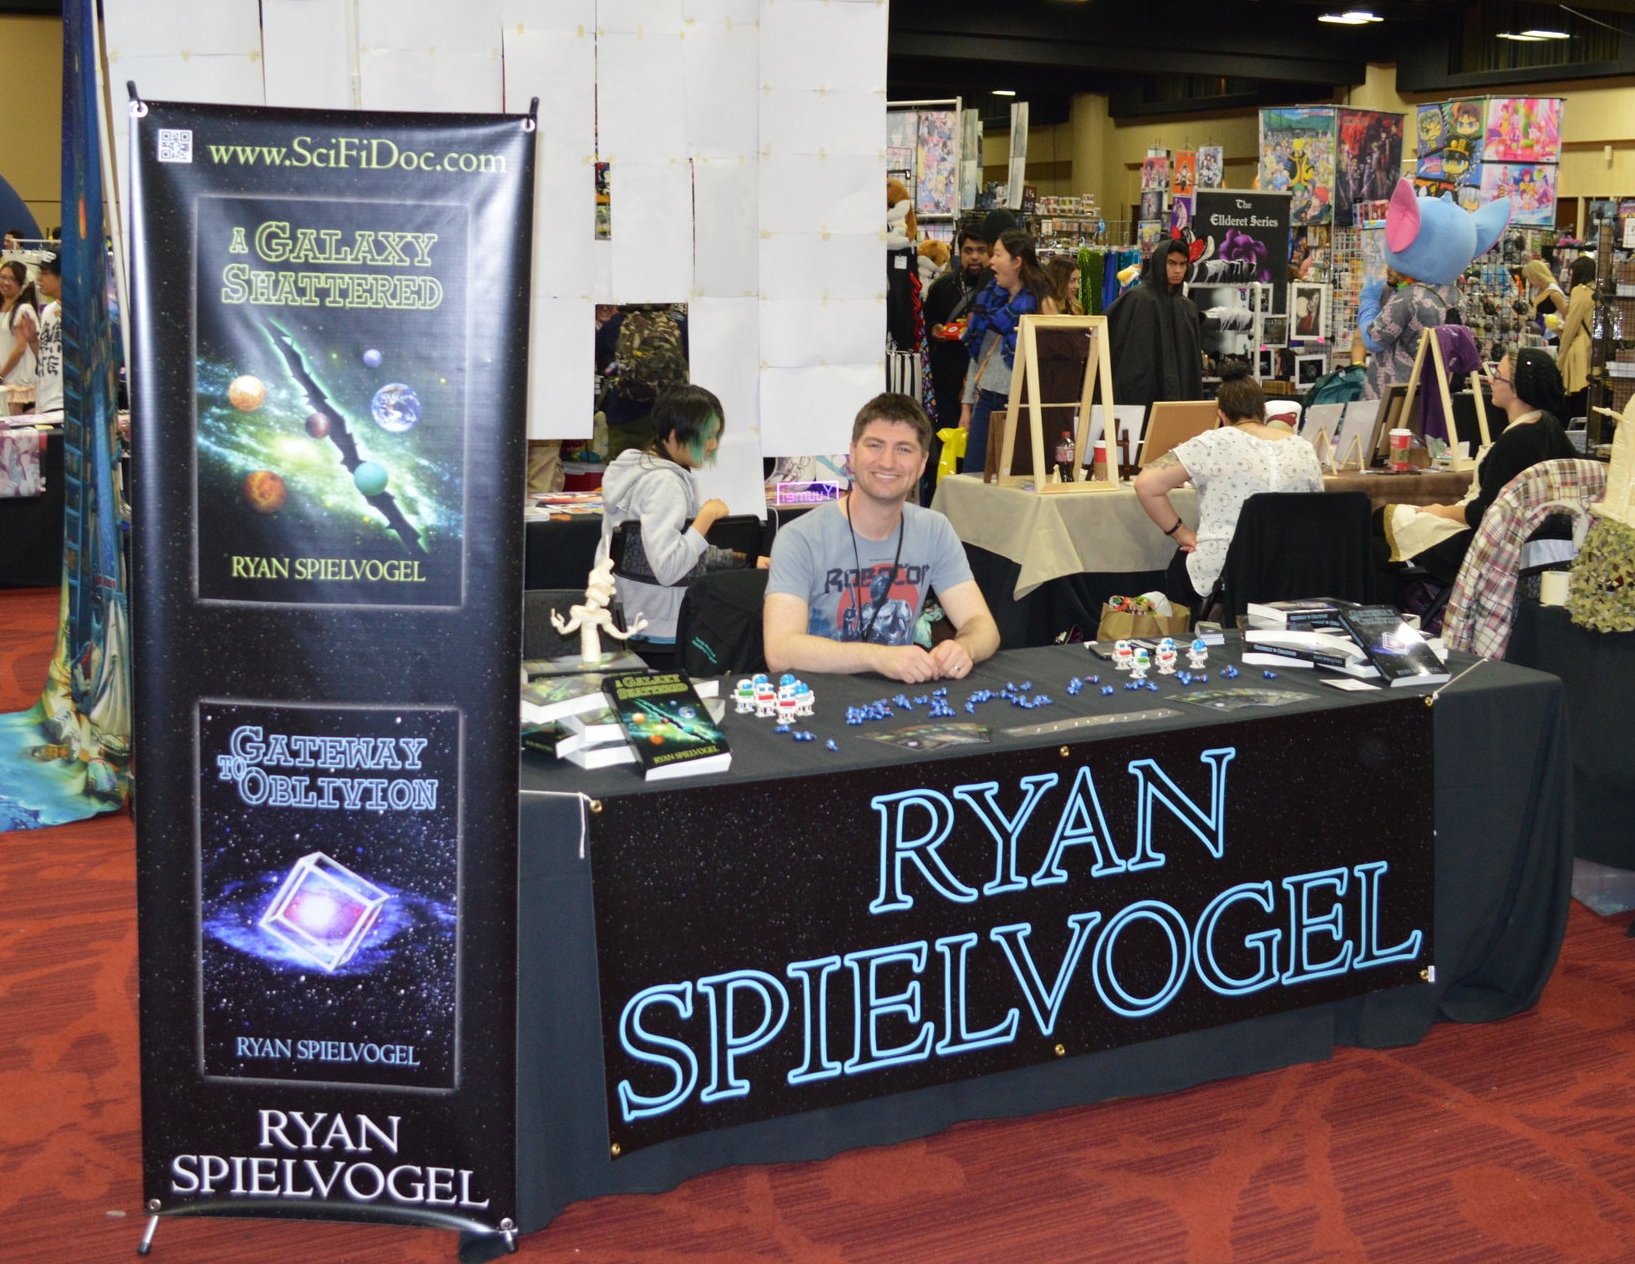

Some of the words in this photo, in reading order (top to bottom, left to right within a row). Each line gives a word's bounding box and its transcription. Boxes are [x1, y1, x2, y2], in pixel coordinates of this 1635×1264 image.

[207, 136, 507, 173] www.SciFiDoc.com
[1210, 213, 1248, 227] Ellderet
[1250, 215, 1279, 228] Series
[1235, 199, 1252, 210] The
[230, 227, 248, 254] A
[254, 221, 438, 266] GALAXY
[221, 264, 443, 310] SHATTERED
[231, 555, 291, 579] RYAN
[294, 557, 427, 583] SPIELVOGEL
[217, 755, 247, 781] TO
[230, 725, 428, 770] GATEWAY
[238, 766, 438, 811] OBLIVION
[870, 747, 1237, 914] RYAN
[618, 861, 1423, 1122] SPIELVOGEL
[236, 1037, 292, 1059] RYAN
[296, 1038, 420, 1067] SPIELVOGEL
[258, 1109, 402, 1154] RYAN
[171, 1153, 490, 1209] SPIELVOGEL
